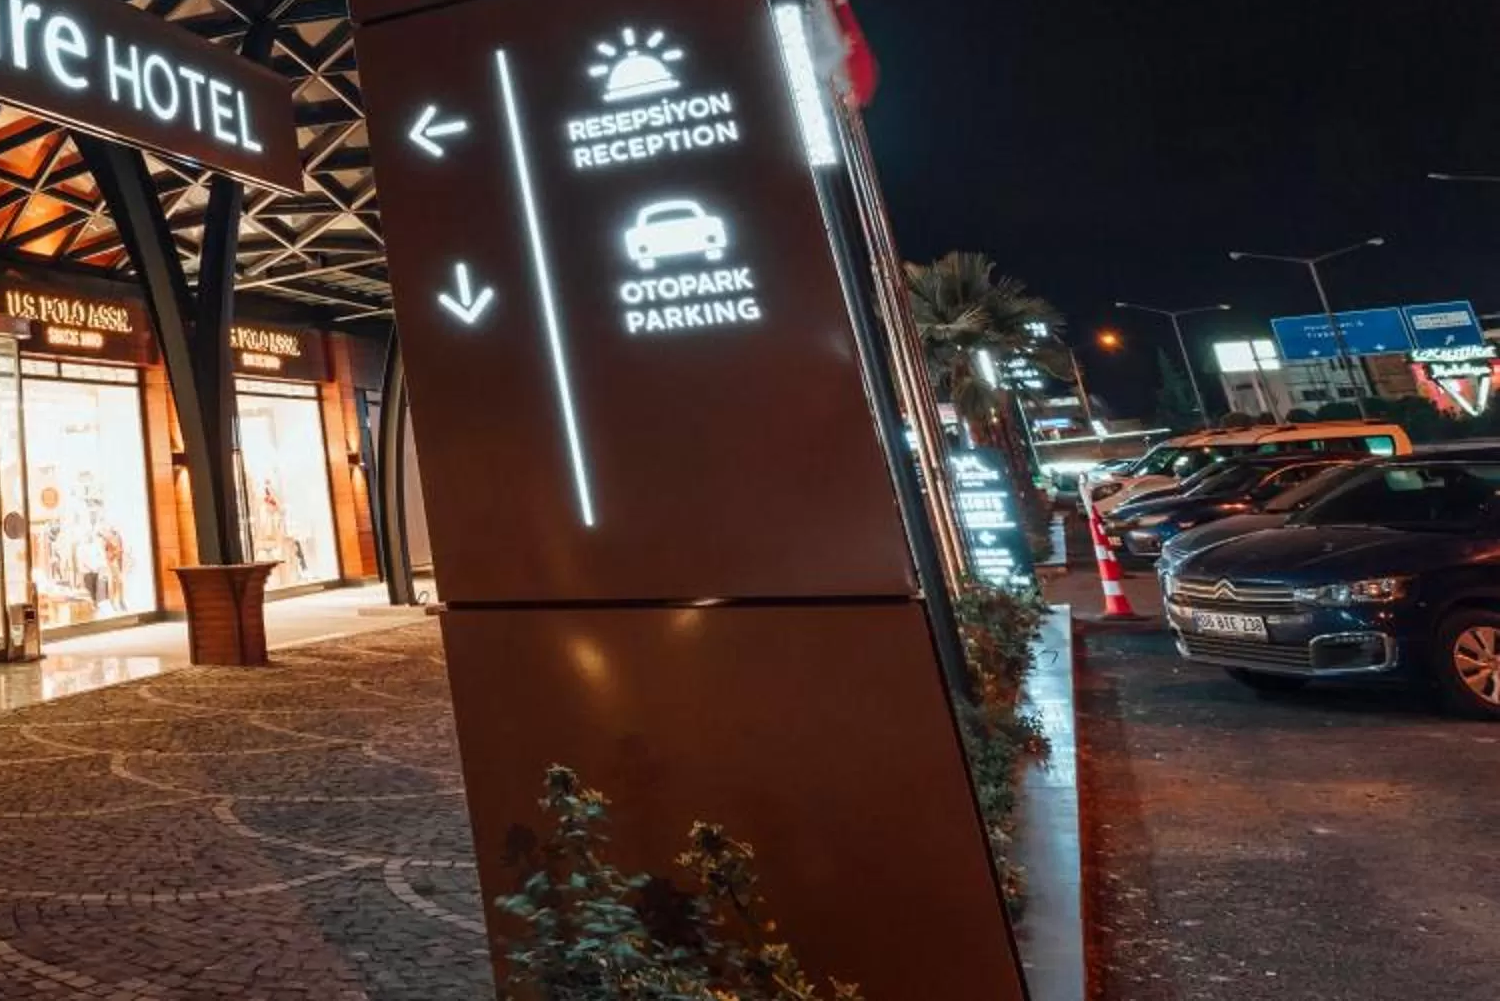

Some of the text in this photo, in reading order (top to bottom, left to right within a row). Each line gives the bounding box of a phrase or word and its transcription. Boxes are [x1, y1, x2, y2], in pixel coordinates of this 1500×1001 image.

[105, 34, 264, 154] HOTEL
[567, 91, 733, 143] RESEPSİYON
[573, 119, 739, 168] RECEPTION
[619, 266, 754, 304] OTOPARK
[39, 296, 85, 327] POLO
[625, 296, 762, 334] PARKING
